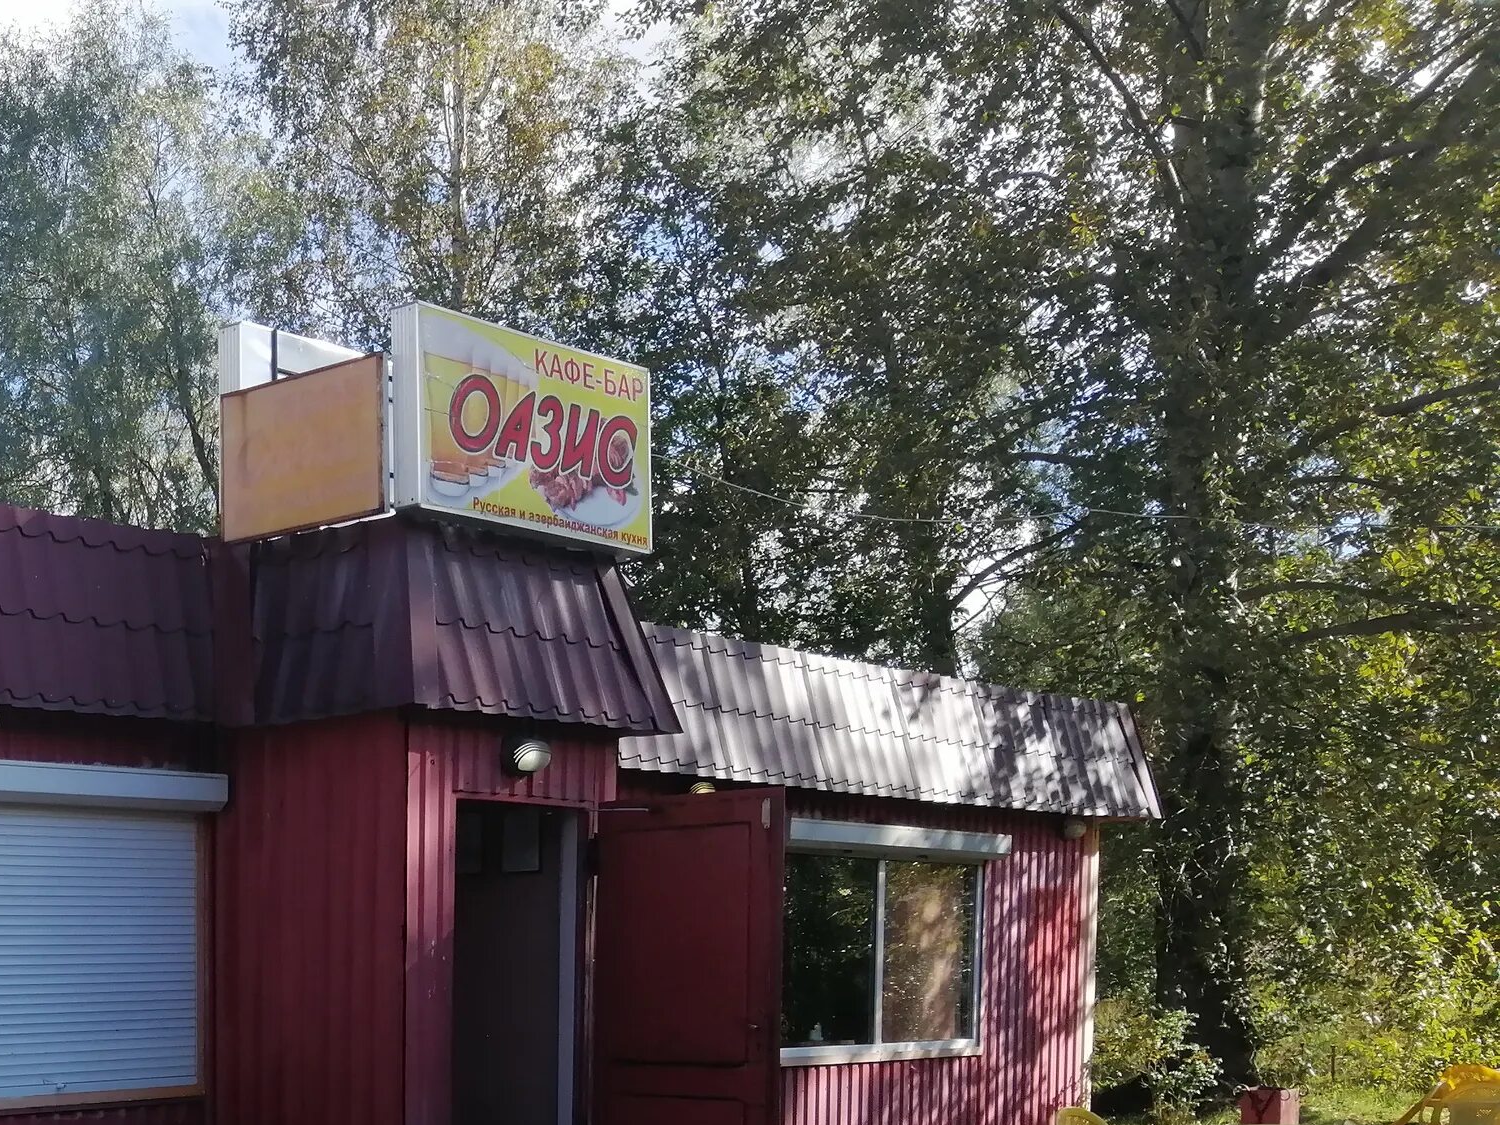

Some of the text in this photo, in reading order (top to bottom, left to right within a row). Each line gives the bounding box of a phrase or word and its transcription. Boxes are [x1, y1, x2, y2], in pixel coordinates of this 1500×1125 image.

[534, 348, 644, 402] КАФЕ-БАР
[449, 374, 638, 487] ОАЗИС
[472, 496, 516, 518] Русская
[519, 510, 526, 520] и
[621, 532, 648, 546] кухня
